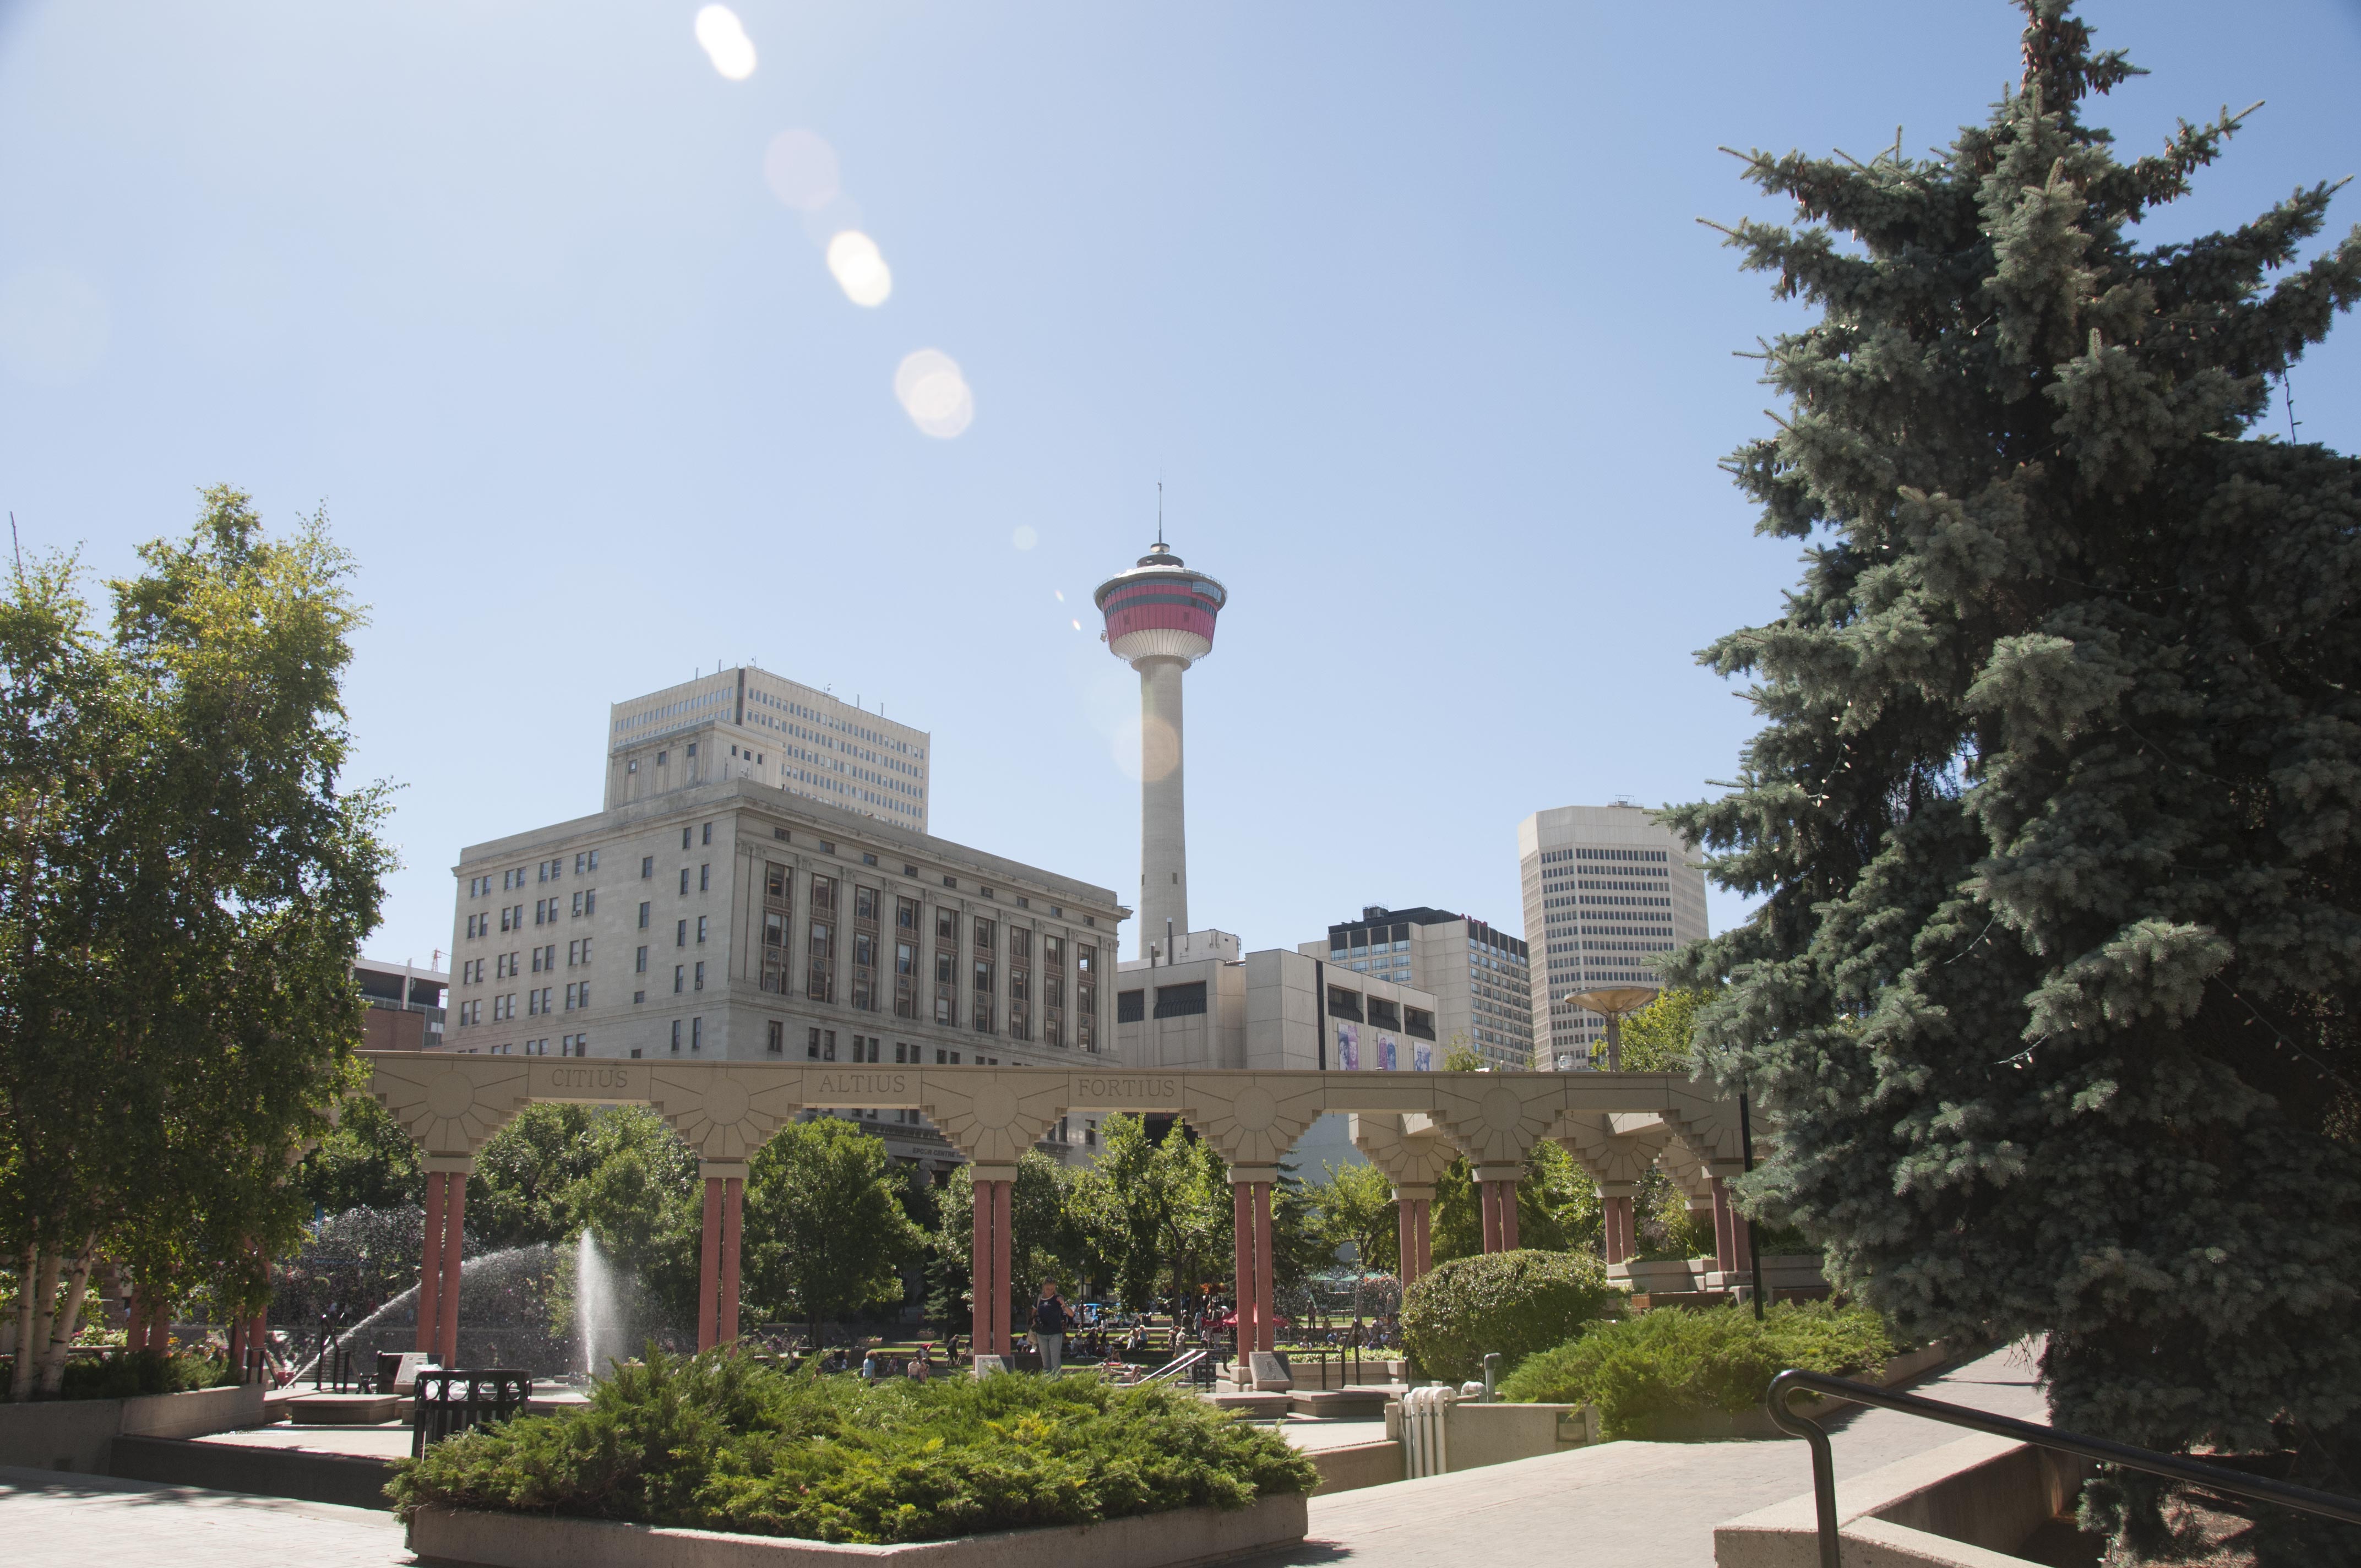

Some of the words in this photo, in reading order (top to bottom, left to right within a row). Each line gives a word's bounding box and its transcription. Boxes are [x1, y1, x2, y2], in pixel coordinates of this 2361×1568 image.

[552, 1069, 628, 1088] CITIUS
[818, 1074, 905, 1093] ALTIUS
[1078, 1079, 1174, 1097] FORTIUS
[933, 1150, 955, 1158] CENTRE
